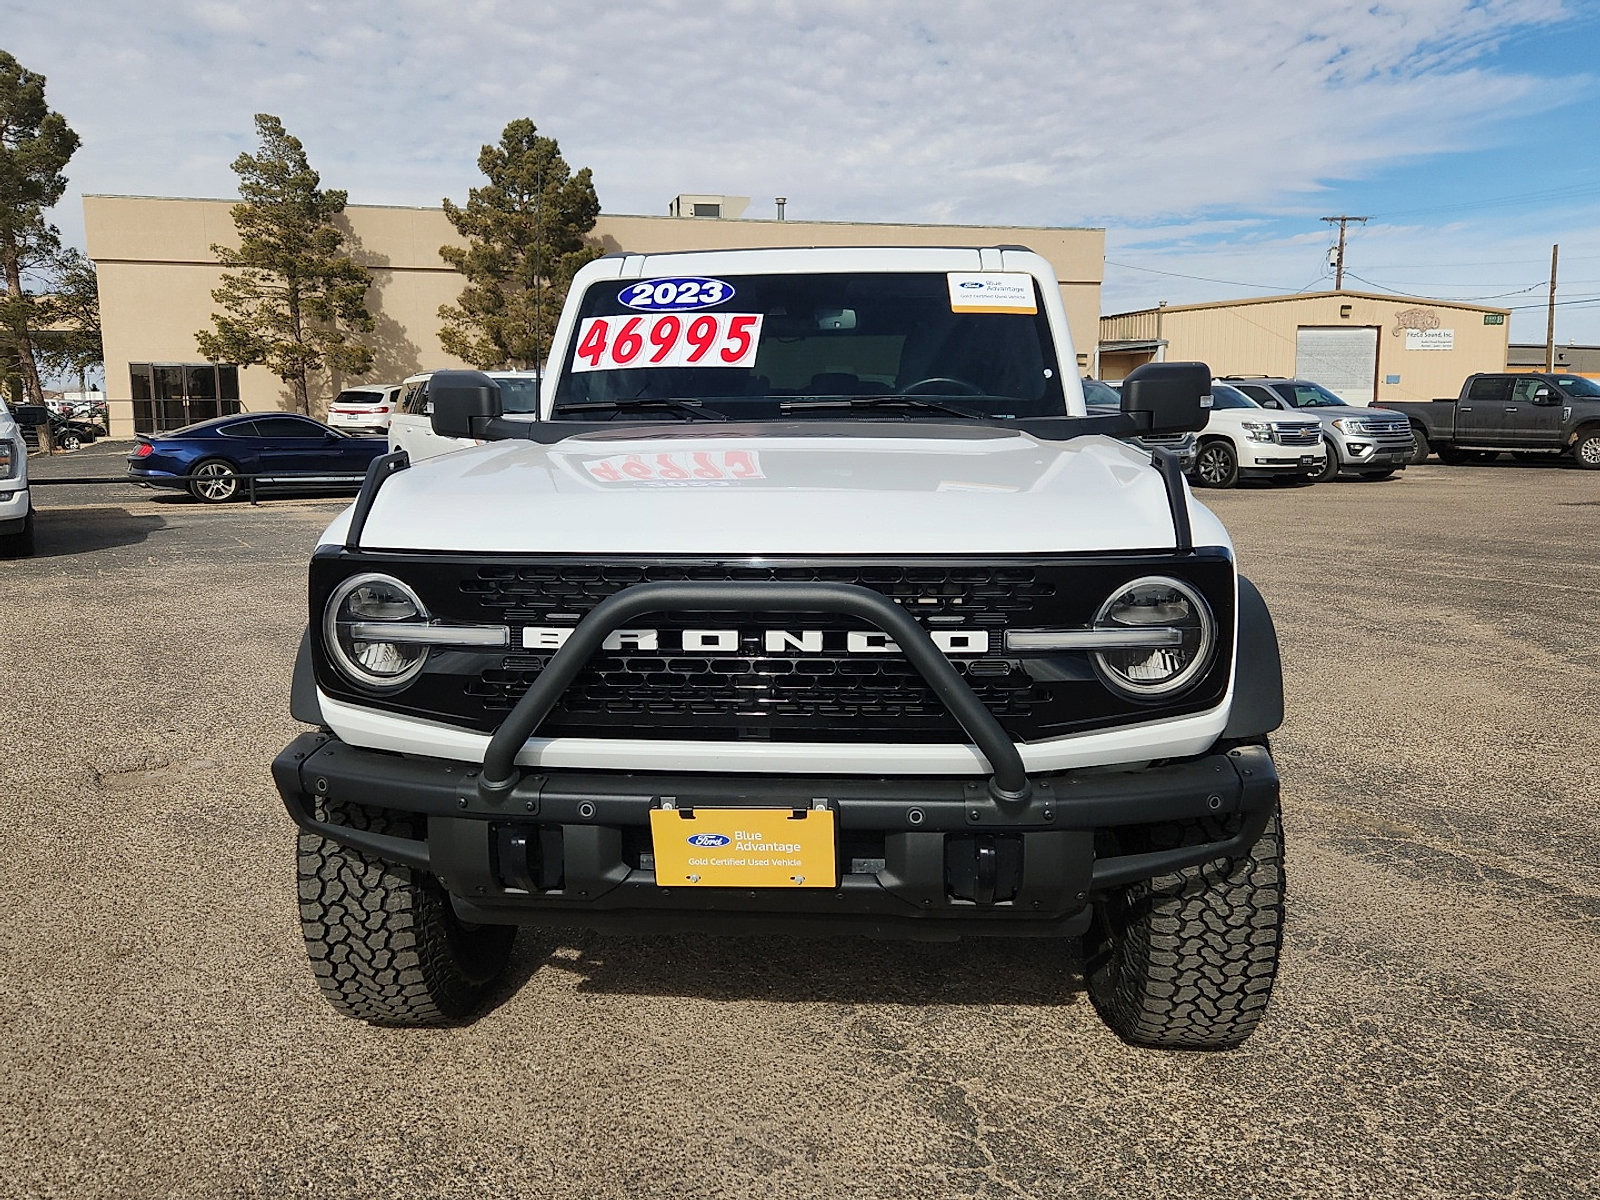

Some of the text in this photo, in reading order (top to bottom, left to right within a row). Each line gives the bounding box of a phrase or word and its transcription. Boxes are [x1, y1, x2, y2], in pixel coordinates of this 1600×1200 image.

[629, 282, 723, 306] 2023
[577, 315, 759, 367] 46995
[522, 626, 989, 653] BRONCO
[693, 834, 725, 847] Ford
[734, 831, 762, 841] Blue
[735, 841, 801, 854] Advantage
[688, 858, 802, 867] Gold Certified Used Vehicle
